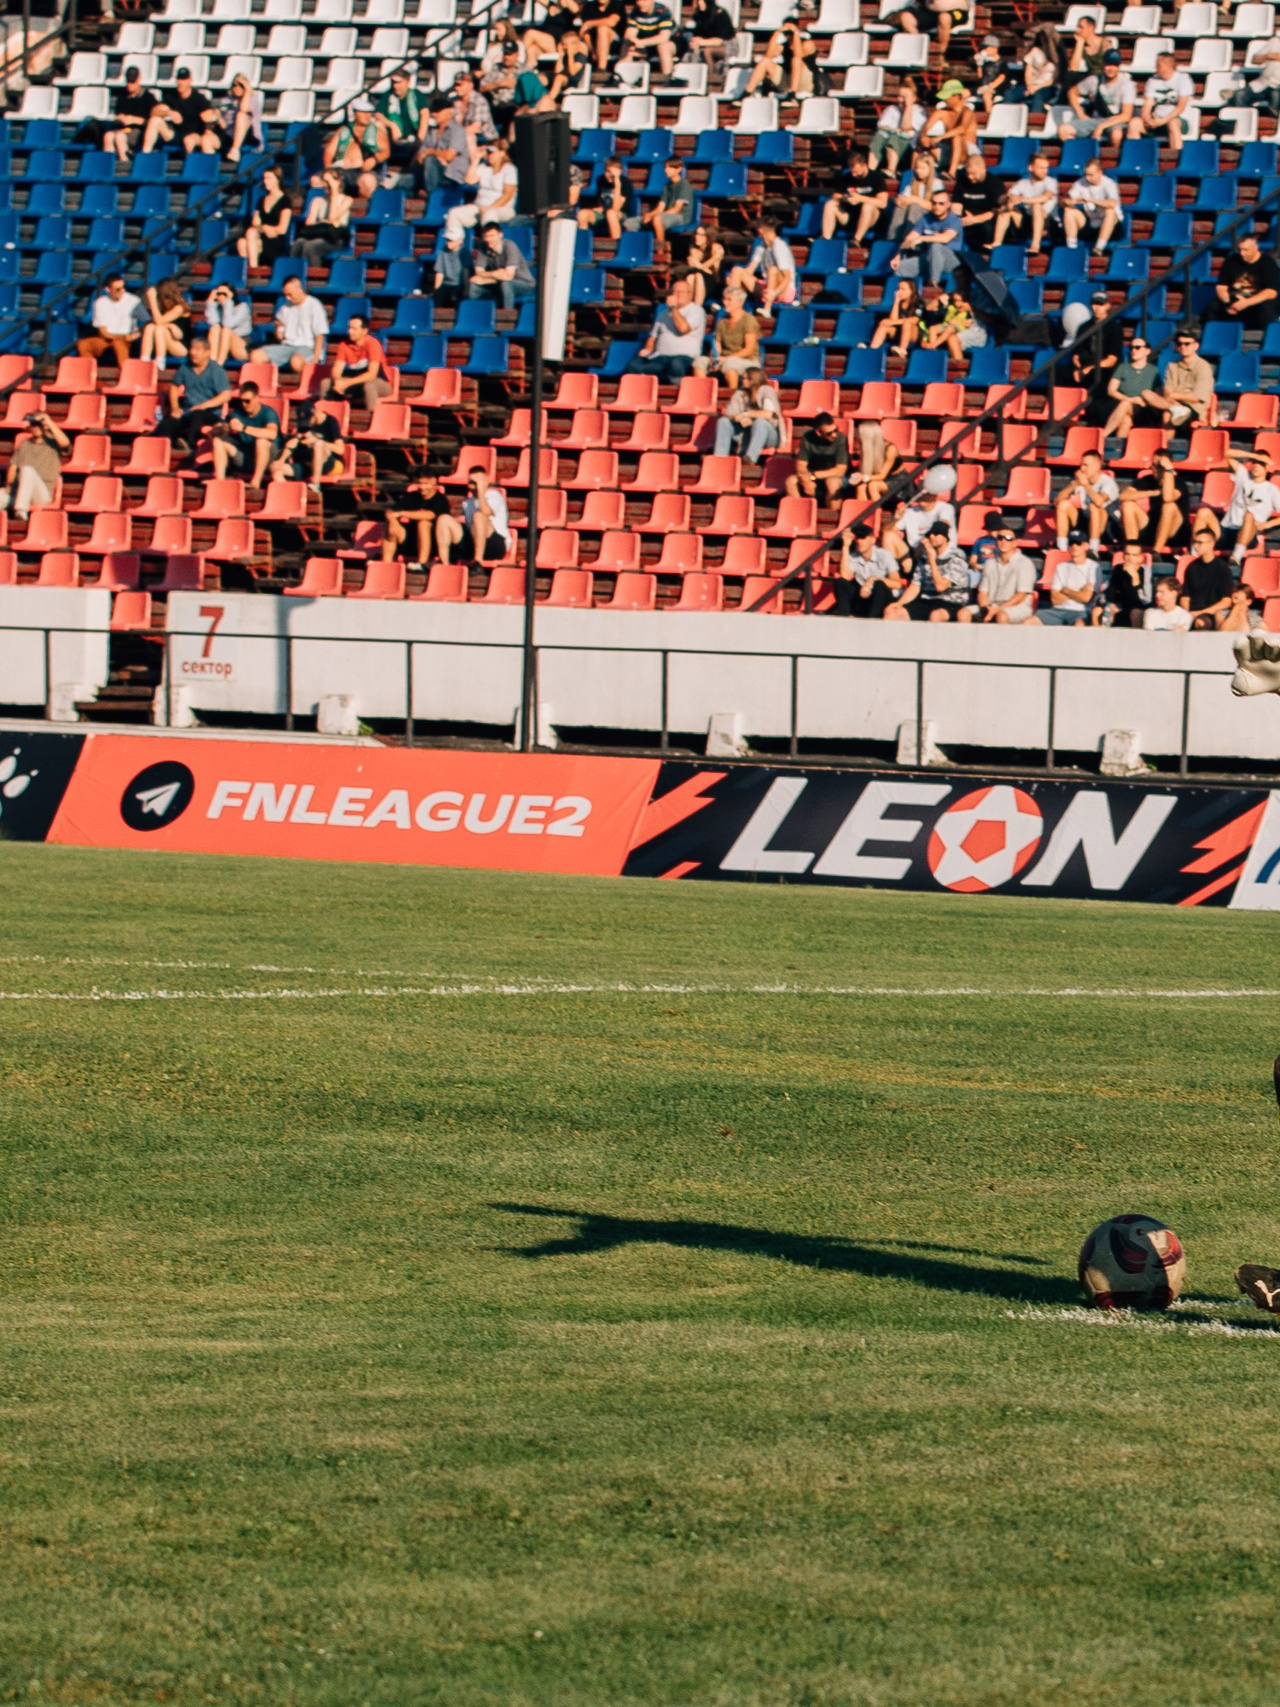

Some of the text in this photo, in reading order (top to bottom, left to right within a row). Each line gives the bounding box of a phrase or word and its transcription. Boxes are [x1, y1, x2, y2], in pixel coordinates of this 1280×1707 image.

[199, 605, 225, 658] 7
[182, 661, 232, 679] сектор
[206, 780, 592, 837] FNLEAGUE2
[718, 776, 1178, 893] LEON
